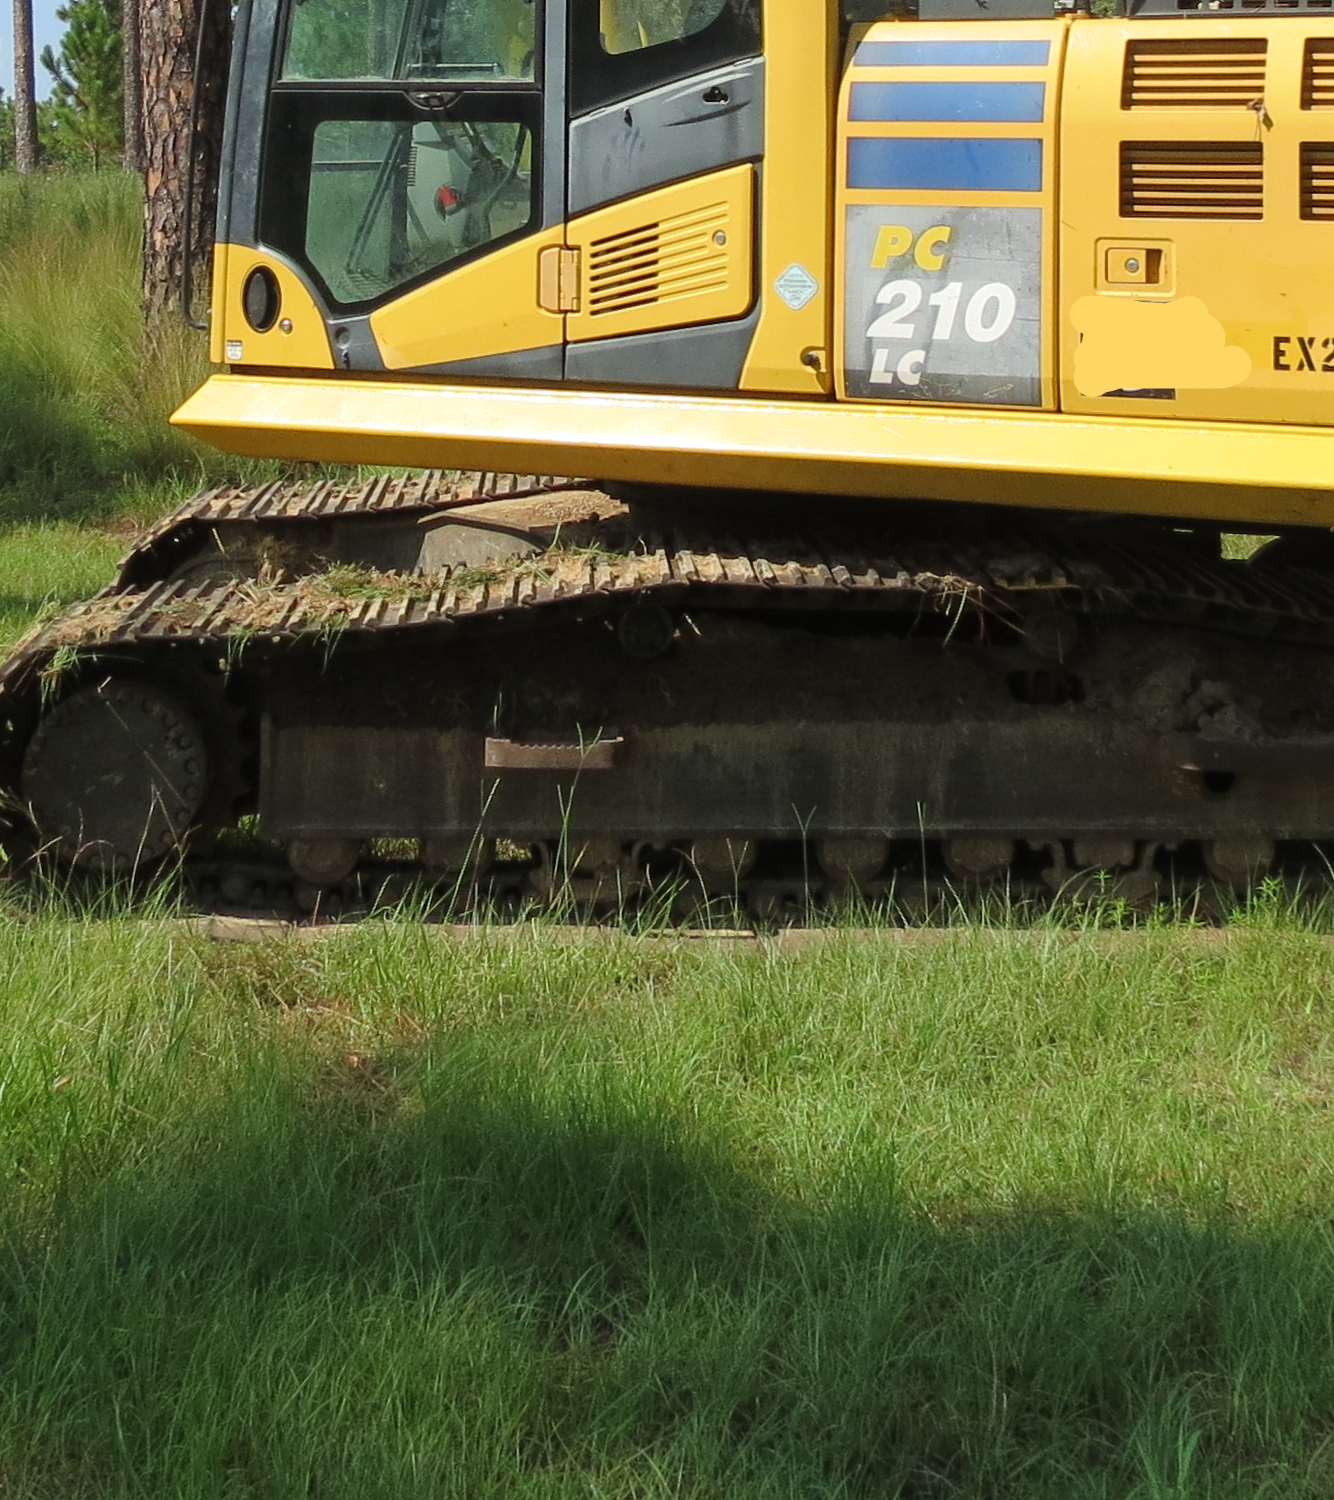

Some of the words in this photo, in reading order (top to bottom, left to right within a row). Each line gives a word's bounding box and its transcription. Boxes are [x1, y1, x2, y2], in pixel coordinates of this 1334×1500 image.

[870, 225, 951, 271] PC
[866, 280, 1016, 342] 210
[869, 348, 926, 385] LC
